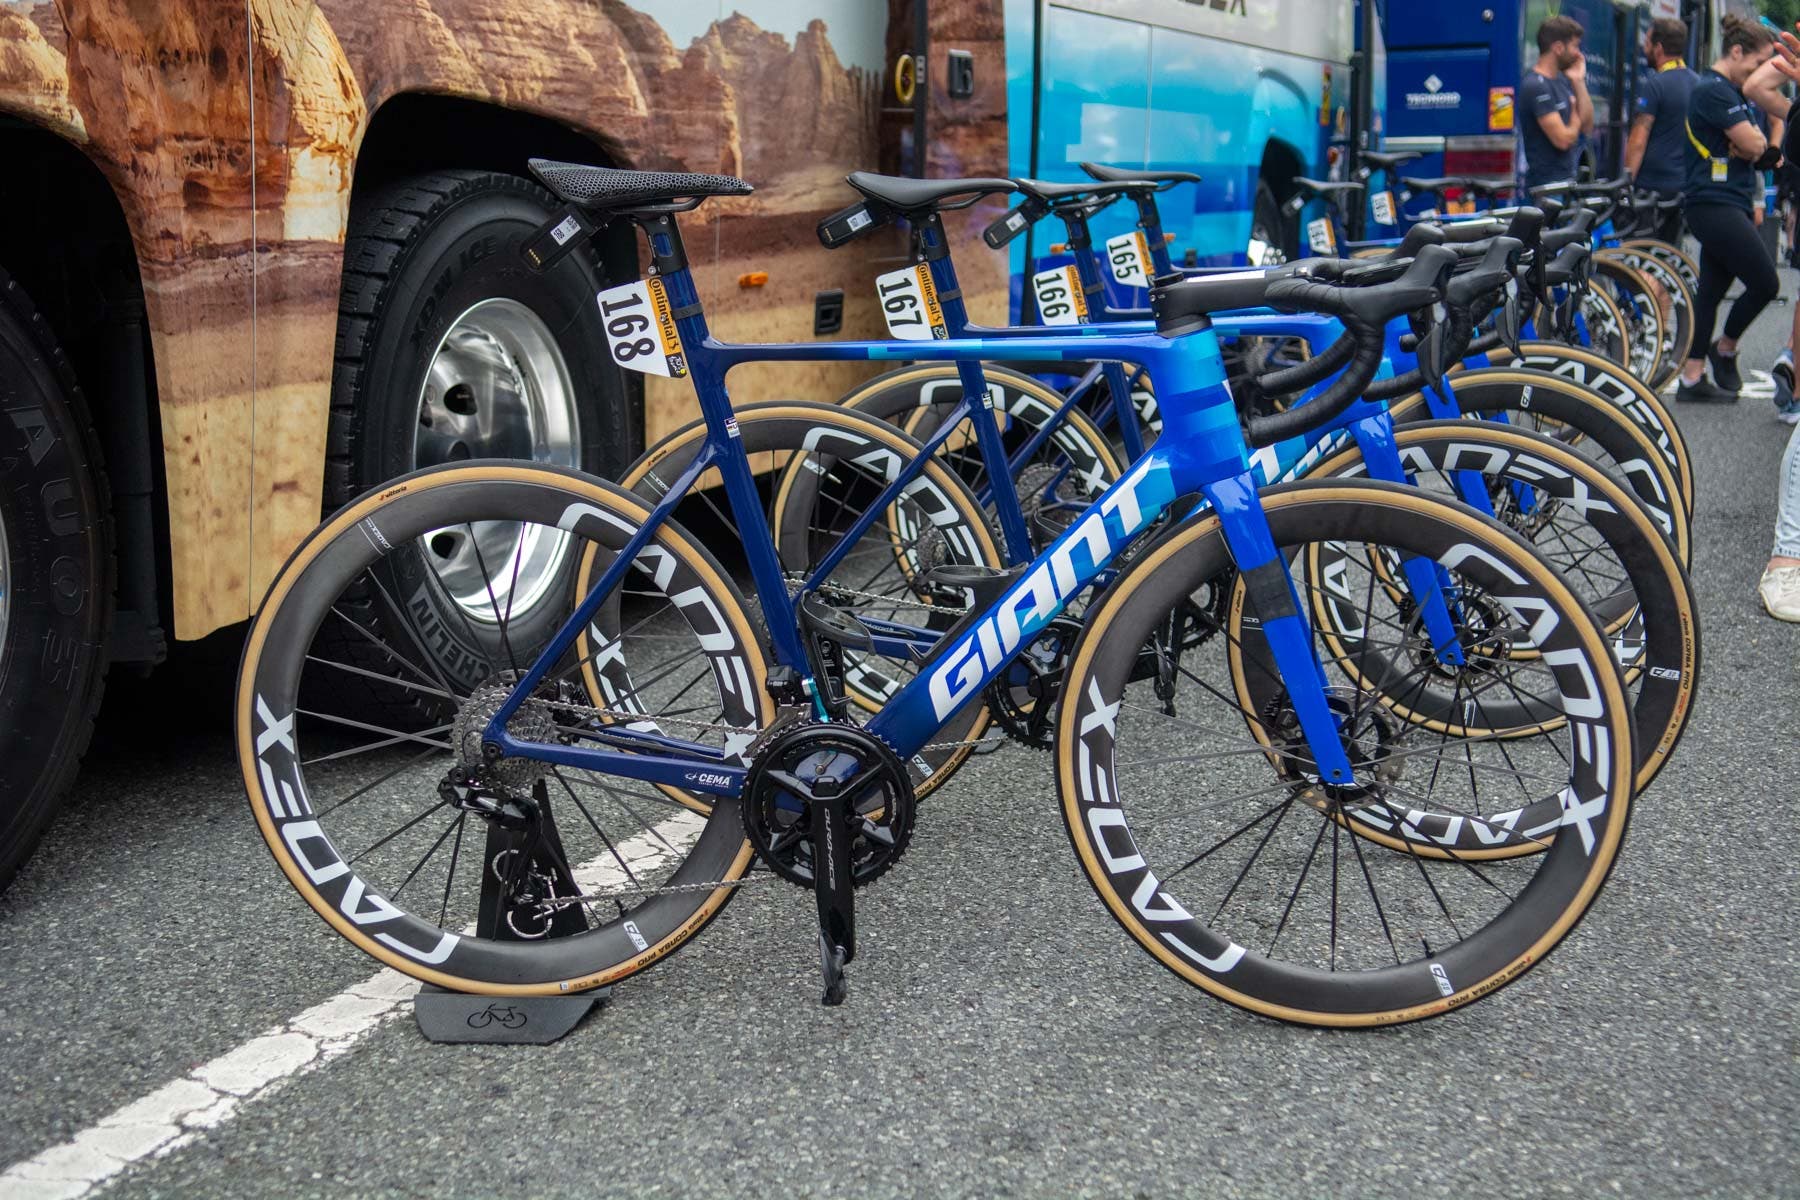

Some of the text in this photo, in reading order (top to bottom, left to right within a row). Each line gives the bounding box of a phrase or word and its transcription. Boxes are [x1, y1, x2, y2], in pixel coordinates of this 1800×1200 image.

[1109, 239, 1139, 279] 165
[601, 293, 656, 362] 168
[650, 276, 678, 342] Continental
[879, 277, 923, 328] 167
[1035, 273, 1071, 319] 166
[1633, 293, 1657, 383] CADE
[385, 486, 407, 498] vittoria
[928, 453, 1155, 724] GIANT
[412, 597, 490, 686] CHELIN
[1437, 542, 1610, 857] CADEX
[698, 773, 731, 786] CEMA
[255, 693, 461, 965] CADEX
[1079, 674, 1247, 974] CADEX
[637, 951, 657, 968] PRO
[658, 929, 688, 955] CORSA
